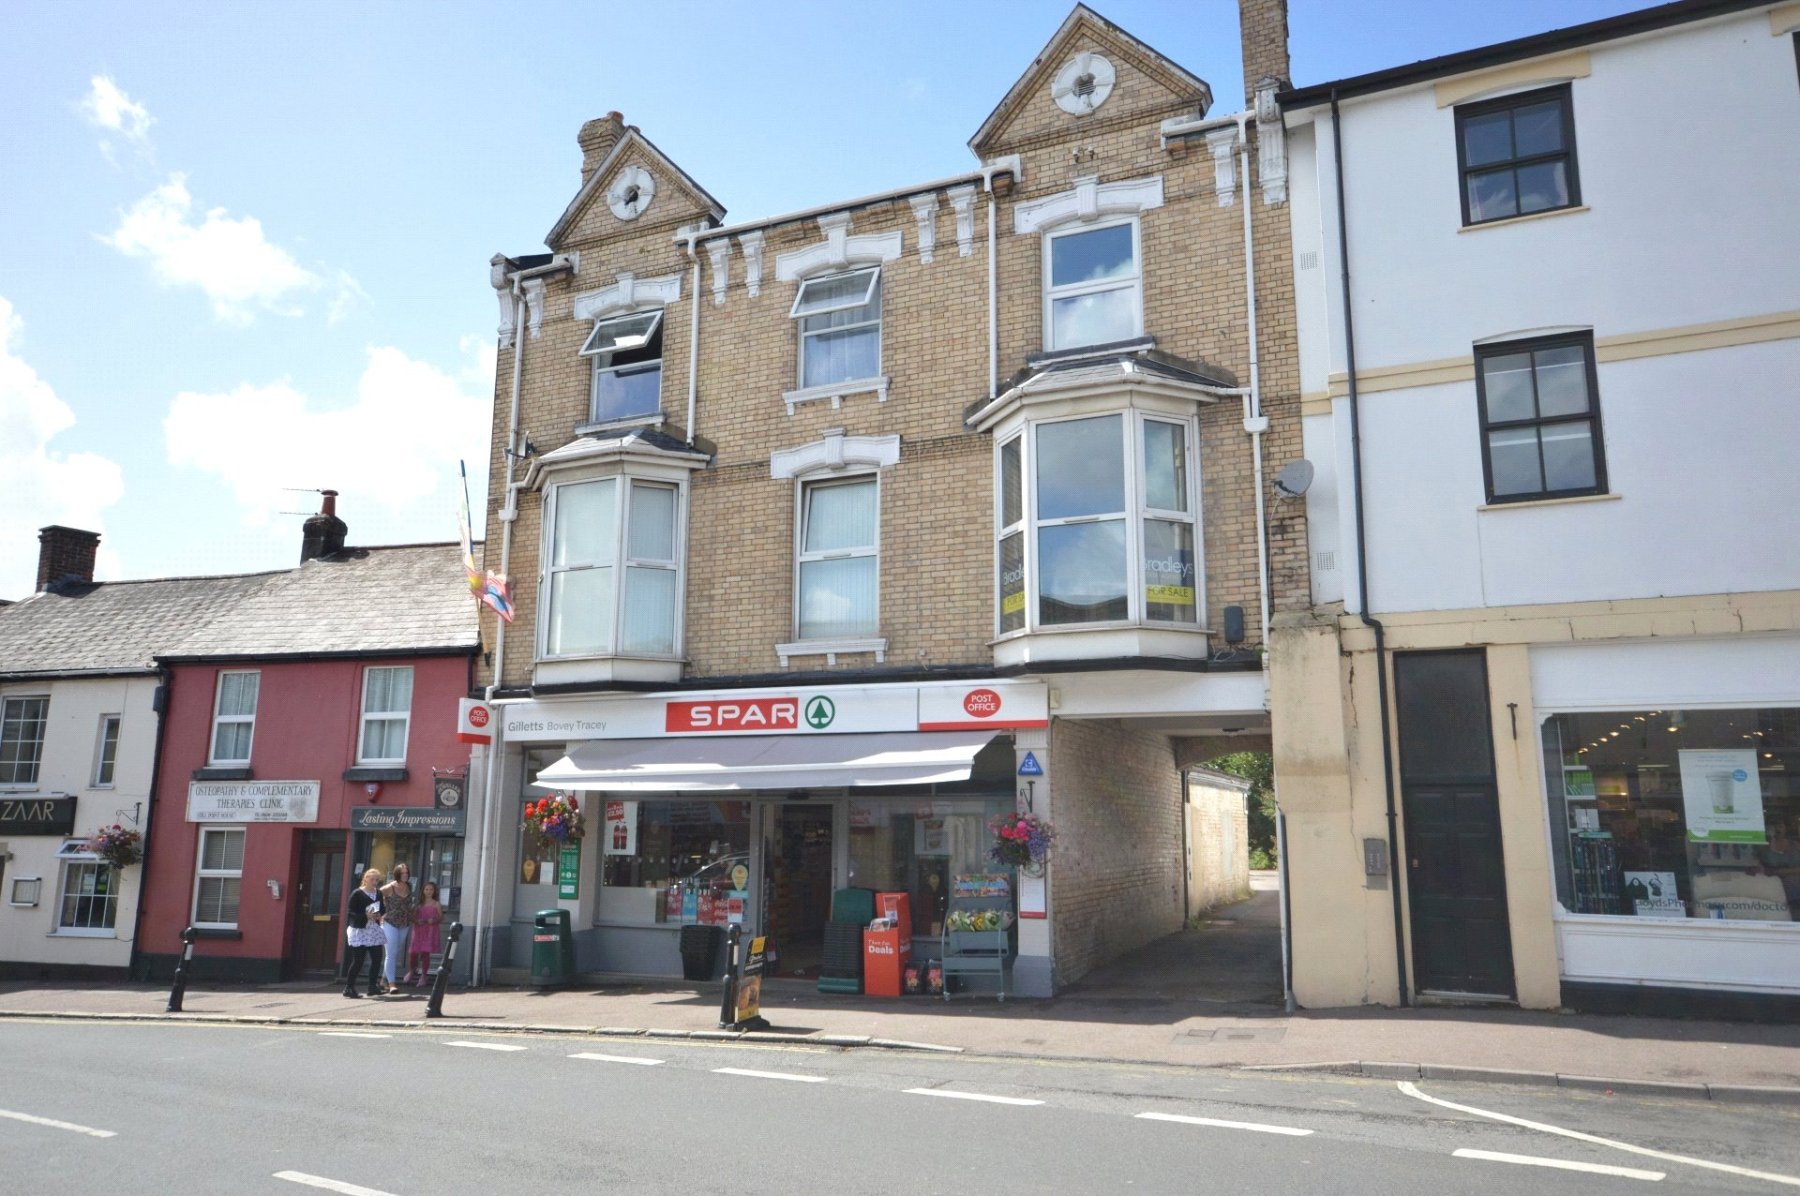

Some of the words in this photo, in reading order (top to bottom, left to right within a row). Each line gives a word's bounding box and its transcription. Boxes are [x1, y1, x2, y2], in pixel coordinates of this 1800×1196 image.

[1145, 556, 1193, 578] radleys
[1167, 587, 1189, 598] SALE
[971, 694, 992, 702] POST
[967, 703, 996, 711] OFFICE
[473, 709, 486, 717] POST
[690, 703, 795, 727] SPAR
[470, 715, 487, 724] OFFICE
[508, 720, 544, 732] Gilletts
[547, 721, 574, 733] Bovey
[576, 720, 607, 732] Tracey
[195, 785, 238, 796] OSTEOPATHY
[247, 785, 313, 796] COMPLEMENTARY
[216, 799, 255, 808] THERAPIES
[259, 799, 284, 808] CLINIC
[360, 809, 395, 826] Lasting
[395, 809, 456, 827] Impressions
[868, 946, 893, 954] Deals
